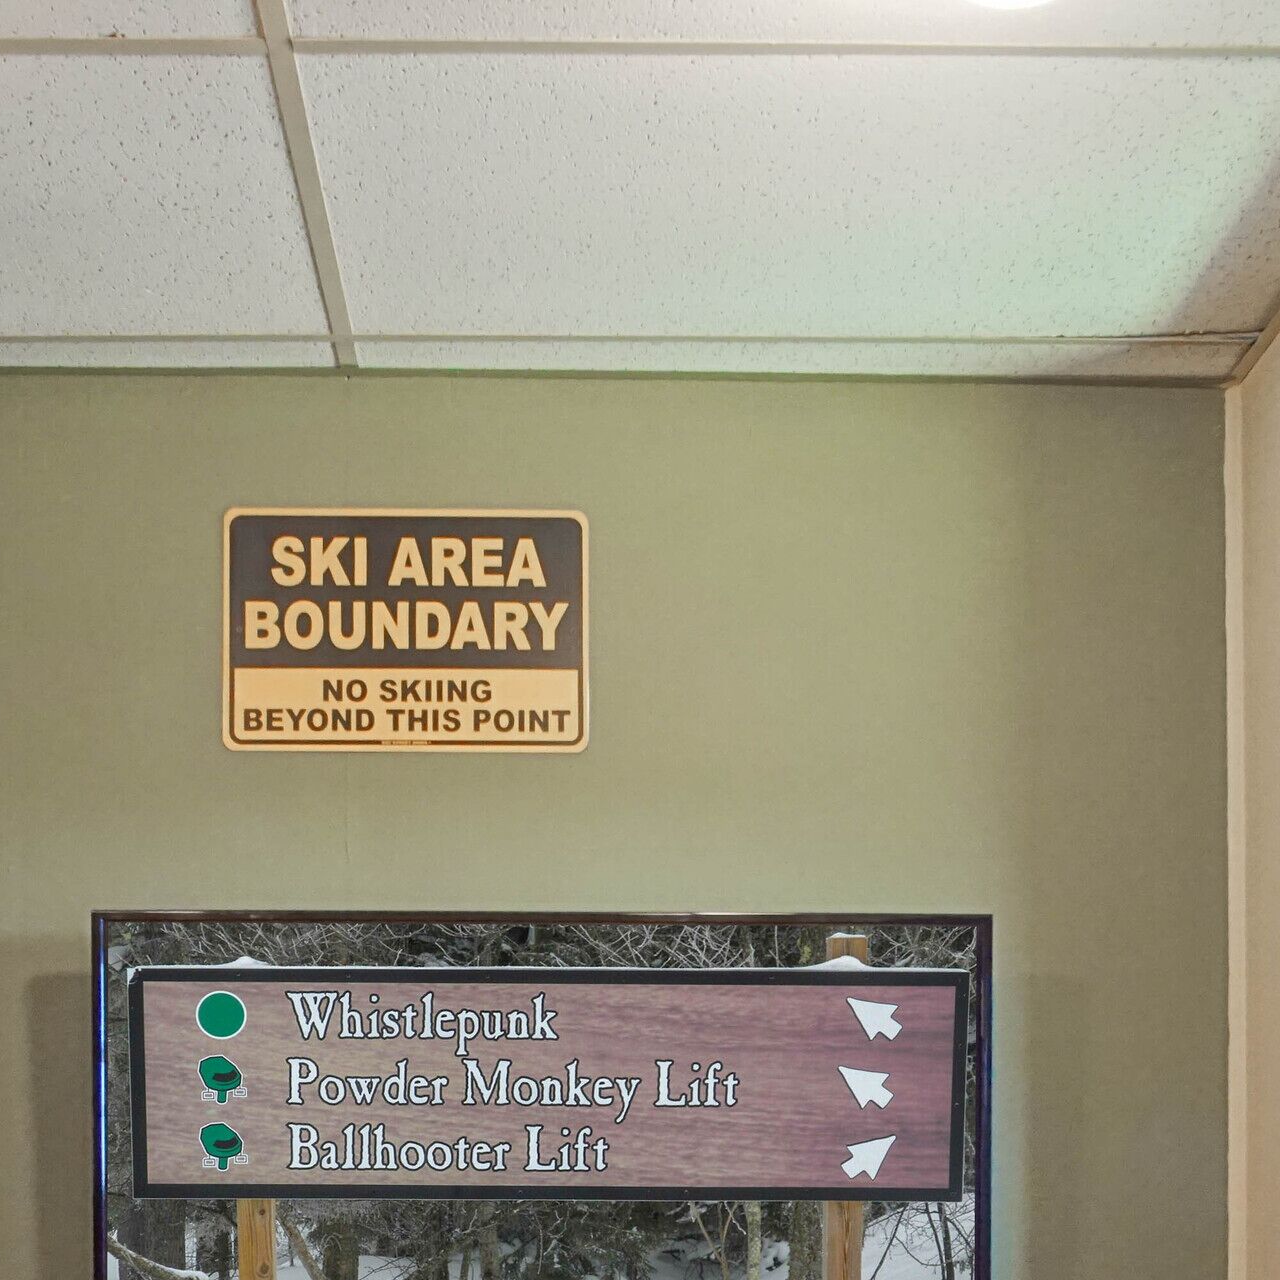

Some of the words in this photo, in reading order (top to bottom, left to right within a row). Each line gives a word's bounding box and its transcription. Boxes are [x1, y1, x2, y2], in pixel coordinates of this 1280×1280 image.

[270, 535, 368, 587] SKI
[387, 536, 547, 588] AREA
[243, 600, 570, 651] BOUNDARY
[322, 679, 368, 703] NO
[379, 679, 493, 703] SKIING
[243, 708, 376, 732] BEYOND
[386, 708, 462, 733] THIS
[473, 709, 571, 733] POINT
[286, 991, 558, 1056] Whistlepunk
[287, 1058, 448, 1106] Powder
[462, 1058, 641, 1124] Monkey
[654, 1060, 739, 1107] Lift
[287, 1123, 511, 1171] Ballhooter
[524, 1125, 609, 1172] Lift
